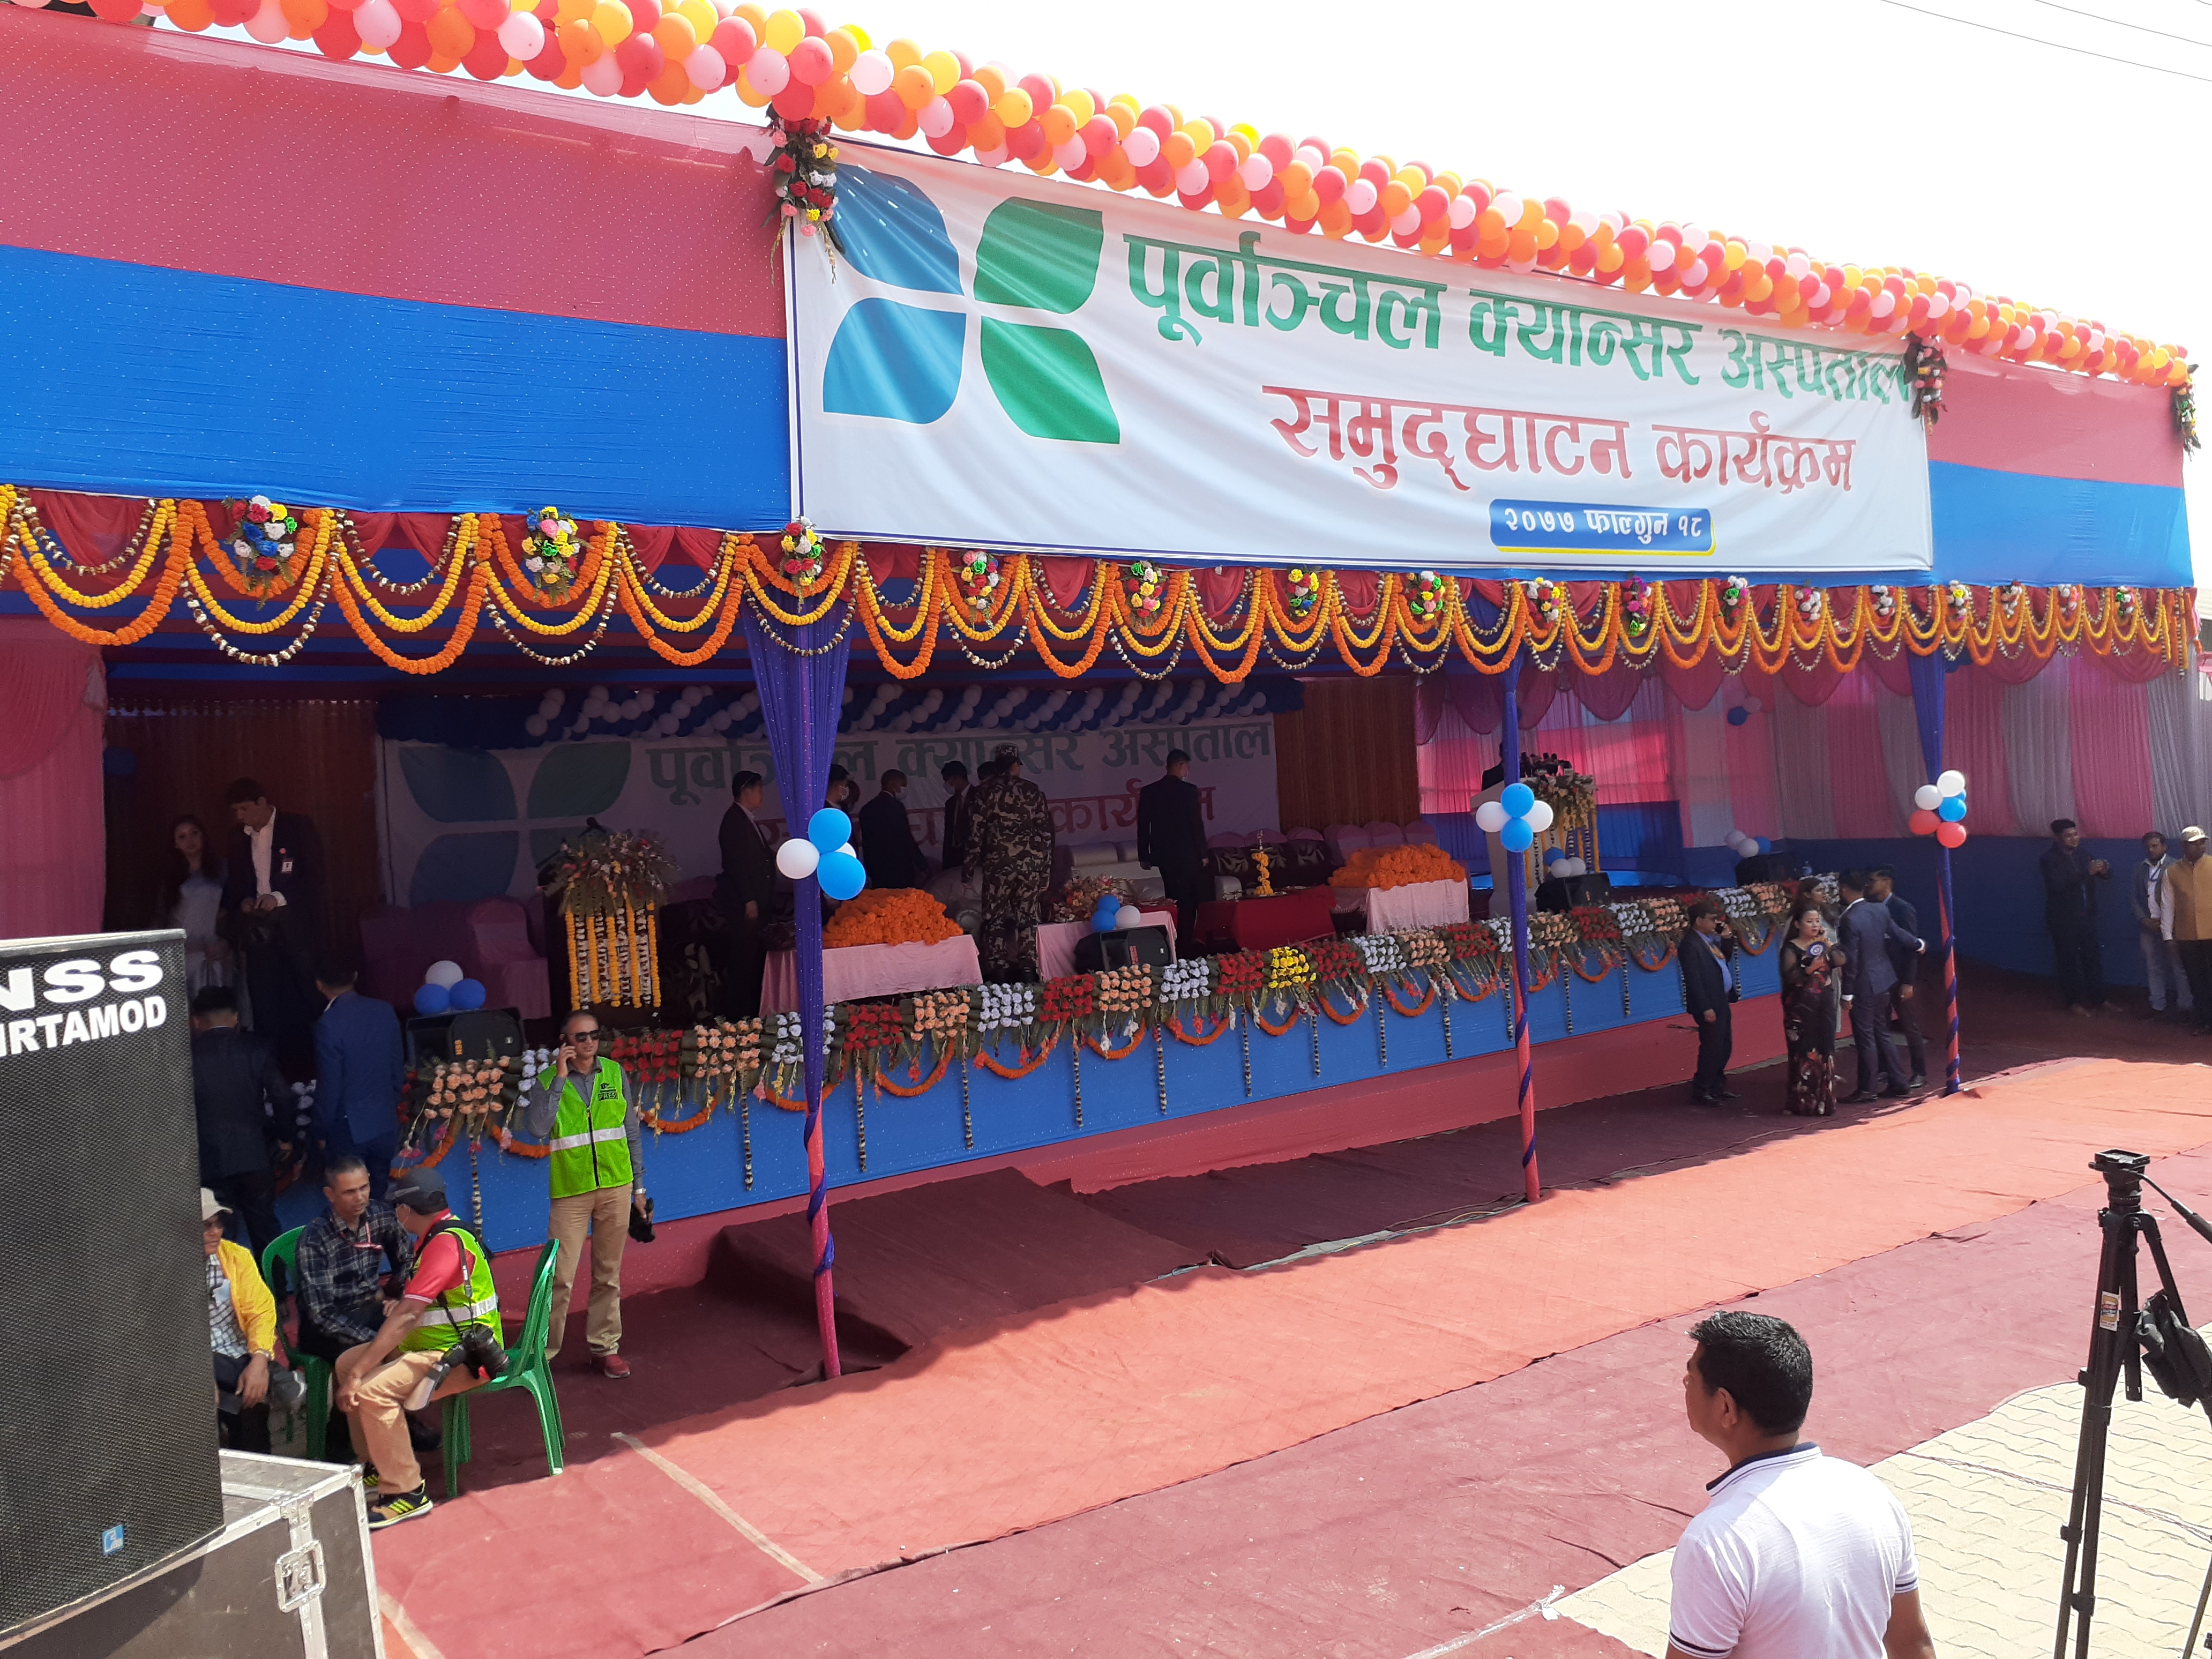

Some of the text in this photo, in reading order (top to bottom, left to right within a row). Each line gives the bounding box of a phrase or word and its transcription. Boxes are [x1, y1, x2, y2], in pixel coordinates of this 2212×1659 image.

[1123, 231, 1909, 405] पूर्वाञ्चल क्यान्सर अस्पताल
[1262, 385, 1856, 495] समुद्घाटन कार्यक्रम
[1504, 507, 1703, 545] २०७७ फाल्गुन १८
[598, 1092, 618, 1100] PRESS
